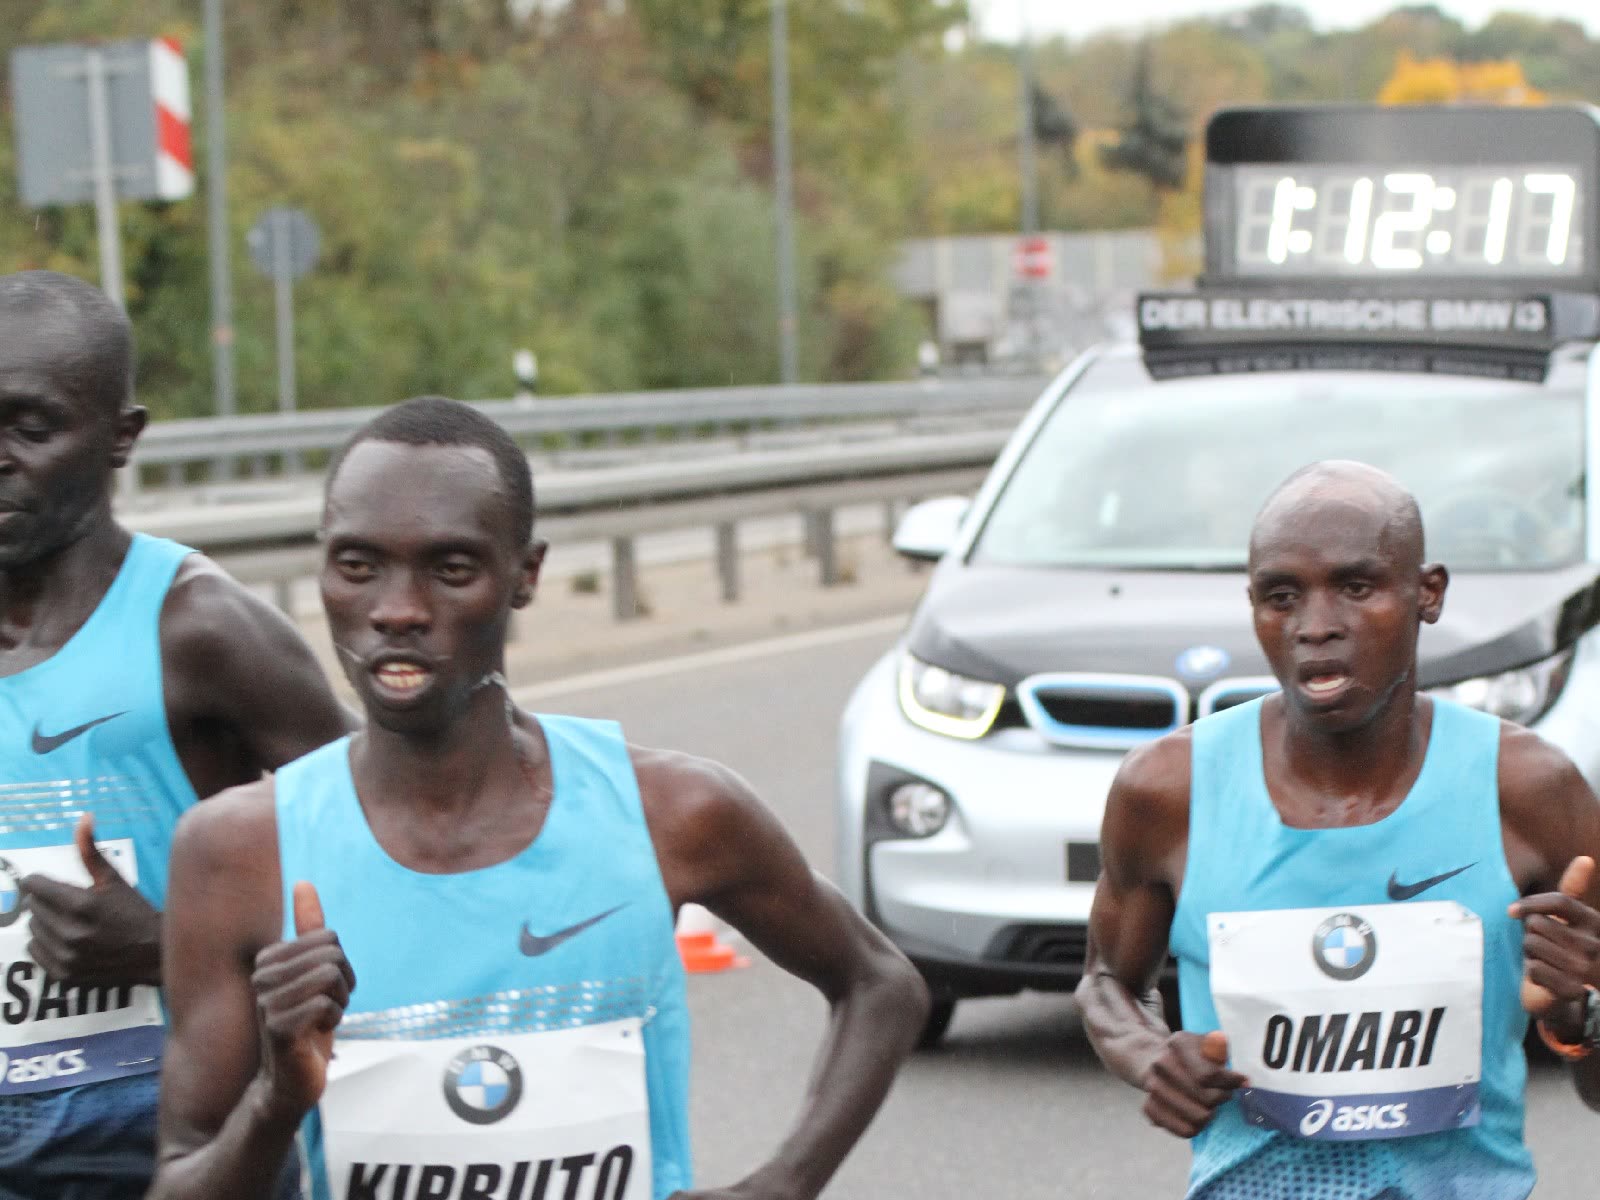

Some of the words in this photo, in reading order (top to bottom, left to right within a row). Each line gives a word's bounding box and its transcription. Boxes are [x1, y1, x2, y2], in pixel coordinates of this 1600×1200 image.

[1266, 173, 1576, 269] 1:12:17
[1142, 300, 1207, 329] DER
[1211, 300, 1425, 330] ELEKTRISCHE
[1431, 300, 1512, 330] BMW
[1262, 1006, 1447, 1073] OMARI
[1331, 1102, 1409, 1132] asics
